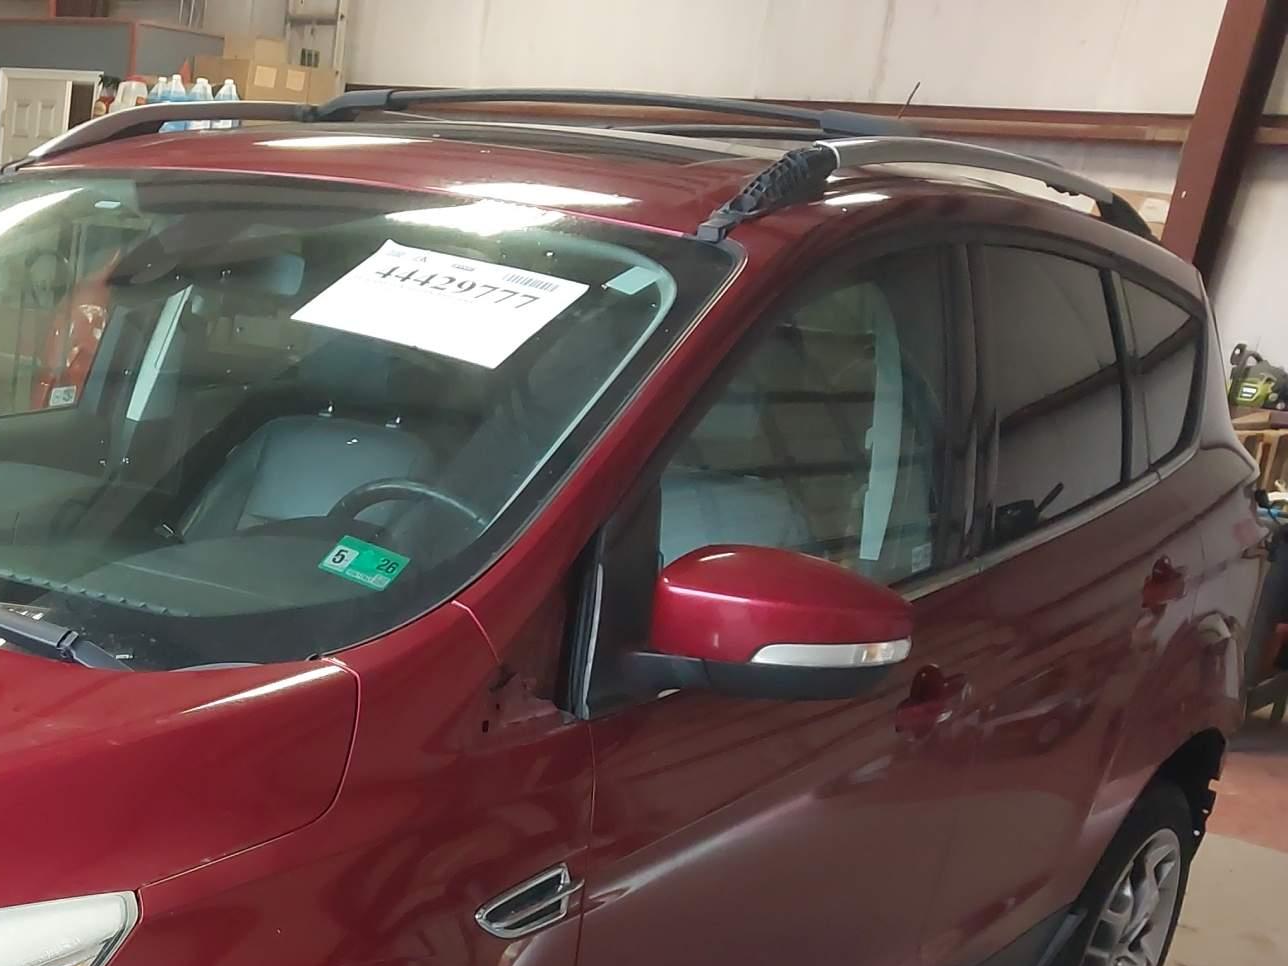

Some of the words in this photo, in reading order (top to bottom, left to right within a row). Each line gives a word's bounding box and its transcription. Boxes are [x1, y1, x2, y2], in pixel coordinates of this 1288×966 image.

[375, 265, 540, 309] 44429777
[332, 549, 348, 564] 5
[376, 558, 399, 574] 26
